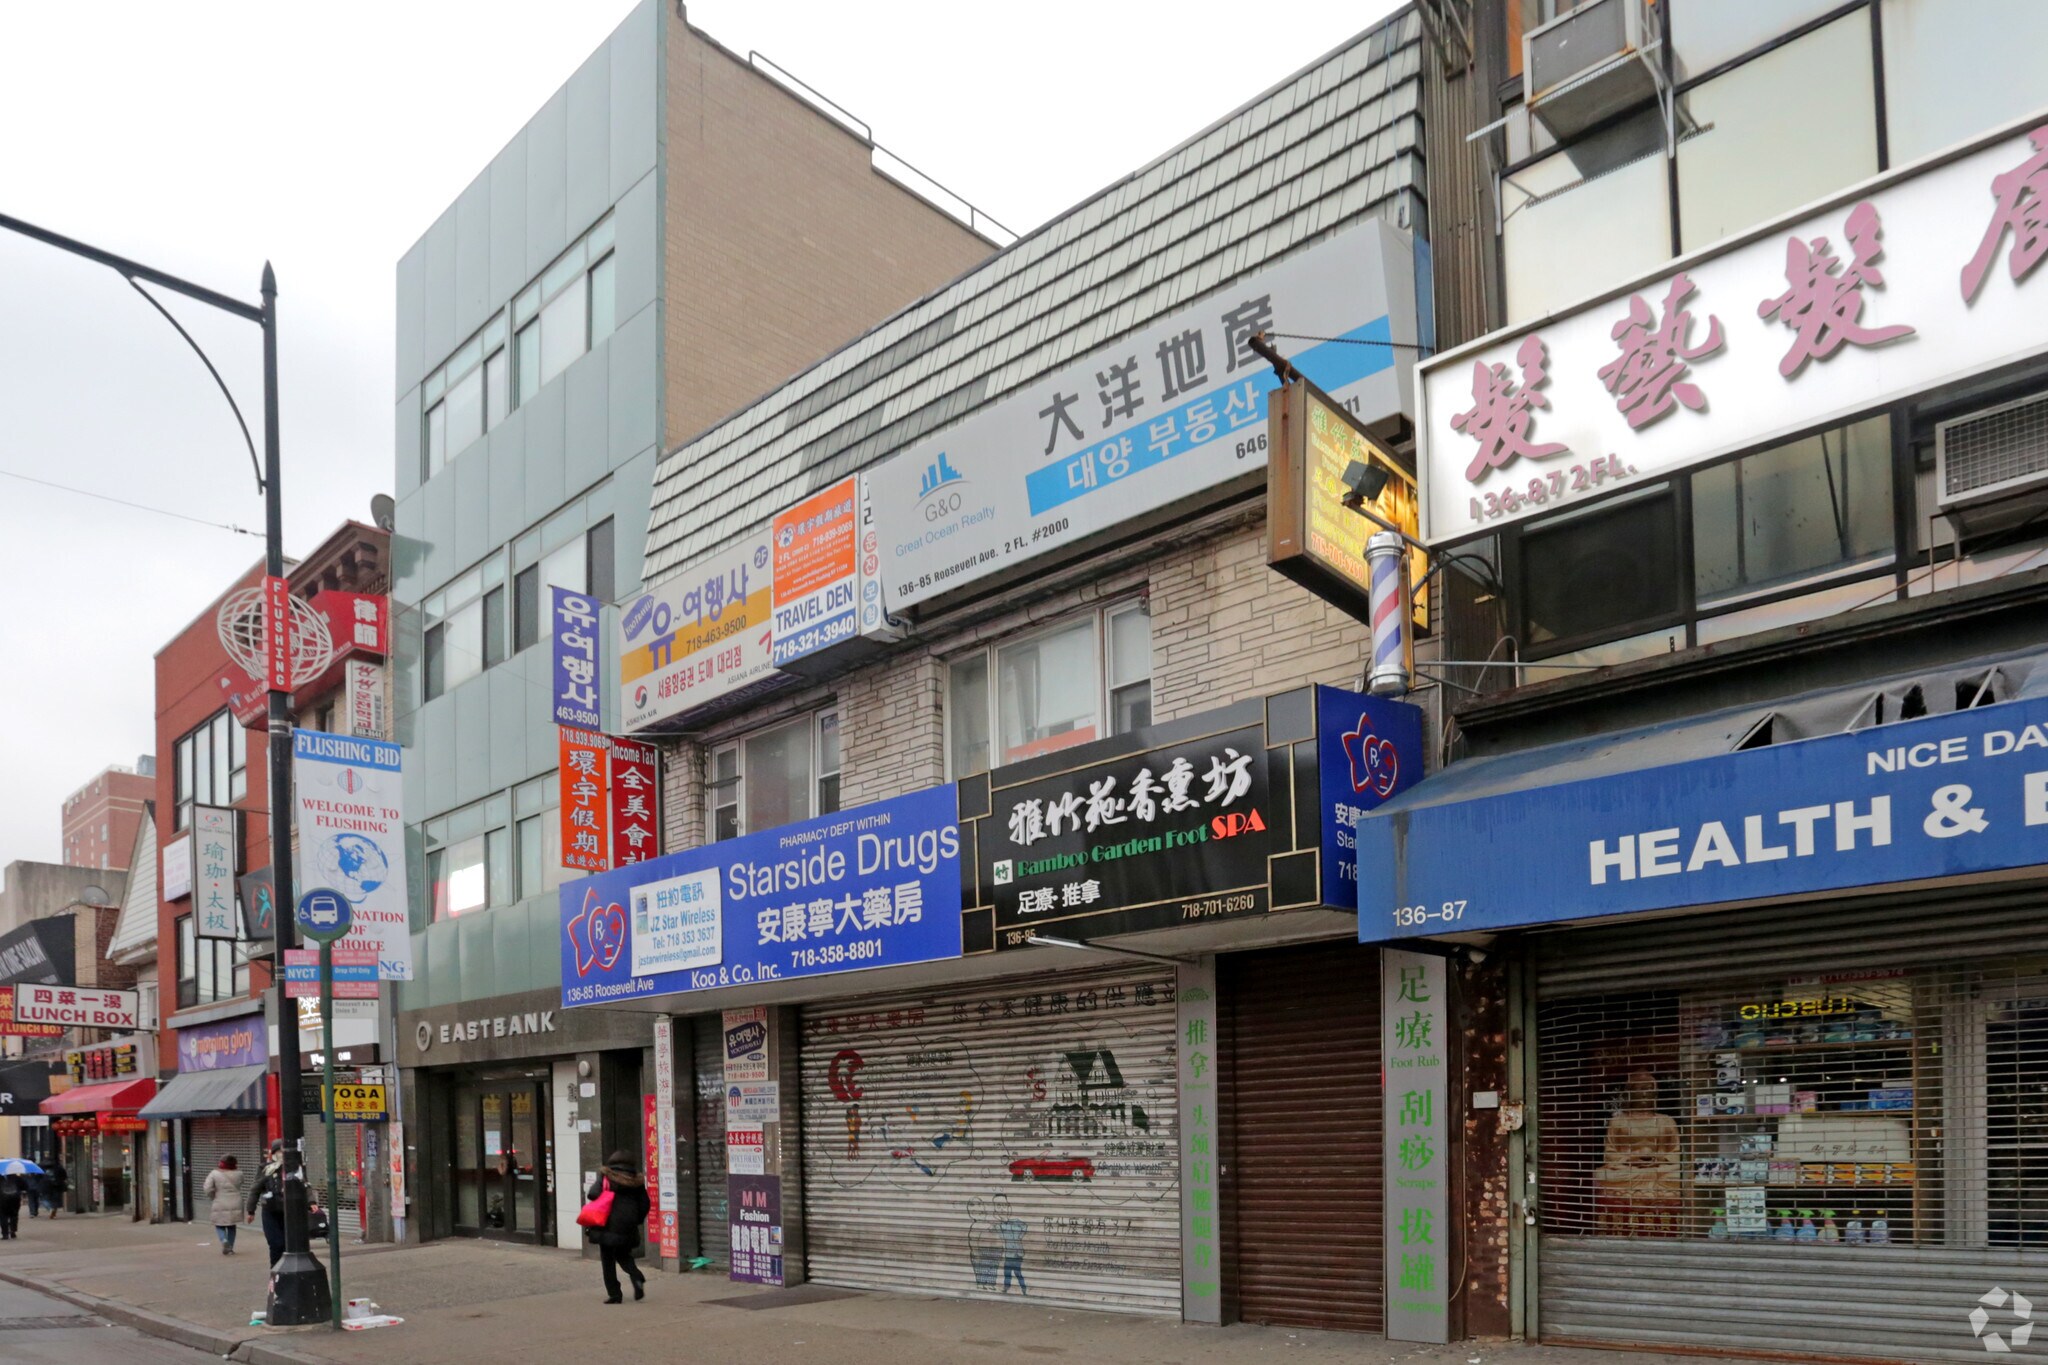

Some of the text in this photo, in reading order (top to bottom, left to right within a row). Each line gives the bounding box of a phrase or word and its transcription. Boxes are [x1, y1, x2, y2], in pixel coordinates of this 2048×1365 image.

[1066, 381, 1259, 490] 대양 부동산
[924, 492, 961, 522] G&O
[895, 505, 995, 557] Great Ocean Realty
[754, 548, 768, 567] 2F
[898, 517, 1069, 598] 136-85 Roosevelt Ave. 2 FL. #2000
[776, 580, 853, 633] TRAVEL DEN
[272, 581, 286, 686] FLUSHING
[353, 598, 378, 647] 律師
[686, 615, 747, 655] 718-463-9500
[774, 615, 855, 662] 718-321-3940
[658, 644, 741, 699] 서울항공권 도매 대리점
[727, 672, 748, 685] ASIANA
[556, 706, 598, 726] 463-9500
[297, 734, 400, 767] FLUSHING BID
[561, 728, 606, 749] 718.939.9069
[612, 741, 655, 765] Income Tax
[1867, 736, 1969, 776] NICE
[302, 798, 400, 820] WELCOME TO
[316, 815, 388, 834] FLUSHING
[779, 812, 891, 849] PHARMACY DEPT WITHIN
[1589, 794, 1892, 886] HEALTH
[1923, 783, 1990, 839] &
[1017, 808, 1266, 878] Bamboo Garden Foot SPA
[728, 825, 960, 901] Starside Drugs
[757, 880, 923, 946] 安康寧大藥房
[1181, 894, 1255, 919] 718-701-6260
[1392, 900, 1468, 927] 136-87
[348, 925, 367, 935] OF
[650, 907, 715, 933] JZ Star Wireless
[331, 939, 385, 952] CHOICE
[653, 926, 715, 949] Tel: 718 353 3637
[1006, 929, 1036, 946] 136-85
[791, 938, 882, 968] 718-358-8801
[287, 968, 317, 979] NYCT
[335, 967, 348, 975] Drop
[358, 967, 371, 975] Only
[691, 963, 781, 989] Koo & Co. Inc.
[567, 978, 654, 1002] 136-85 Roosevelt Ave
[20, 1006, 87, 1023] LUNCH
[93, 1011, 133, 1025] BOX
[440, 1011, 556, 1044] EASTBANK
[6, 1024, 62, 1034] LUNCH BOX
[198, 1028, 253, 1055] morning glory
[1390, 1056, 1440, 1068] Foot Rub
[740, 1209, 769, 1222] Fashion
